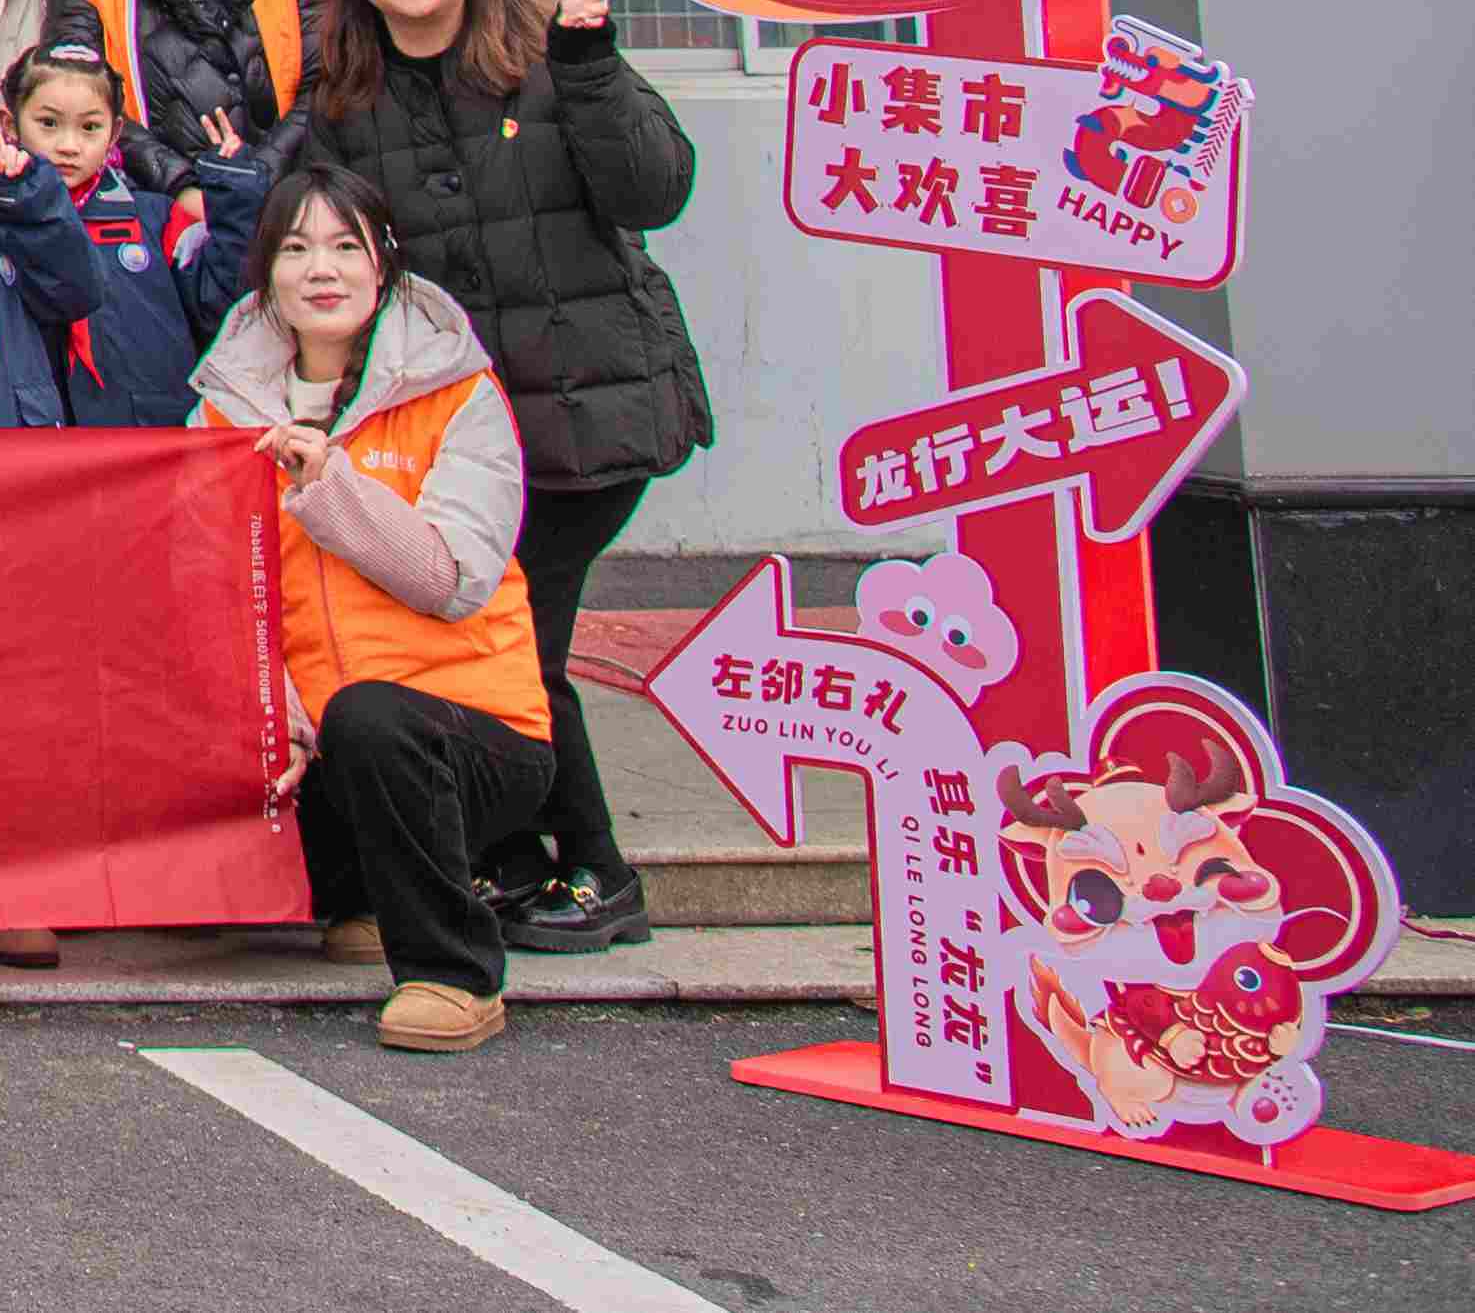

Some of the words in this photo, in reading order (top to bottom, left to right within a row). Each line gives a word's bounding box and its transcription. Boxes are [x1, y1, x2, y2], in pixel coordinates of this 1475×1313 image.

[808, 62, 1026, 143] 小集市
[821, 145, 1038, 239] 大欢喜
[1056, 186, 1184, 261] HAPPY
[711, 653, 910, 736] 左邻右礼
[722, 713, 770, 735] ZUO
[778, 720, 815, 742] LIN
[823, 726, 872, 757] YOU
[876, 757, 899, 782] LI
[900, 815, 920, 843] QI
[905, 851, 924, 884] LE
[908, 894, 928, 965] LONG
[913, 977, 933, 1048] LONG
